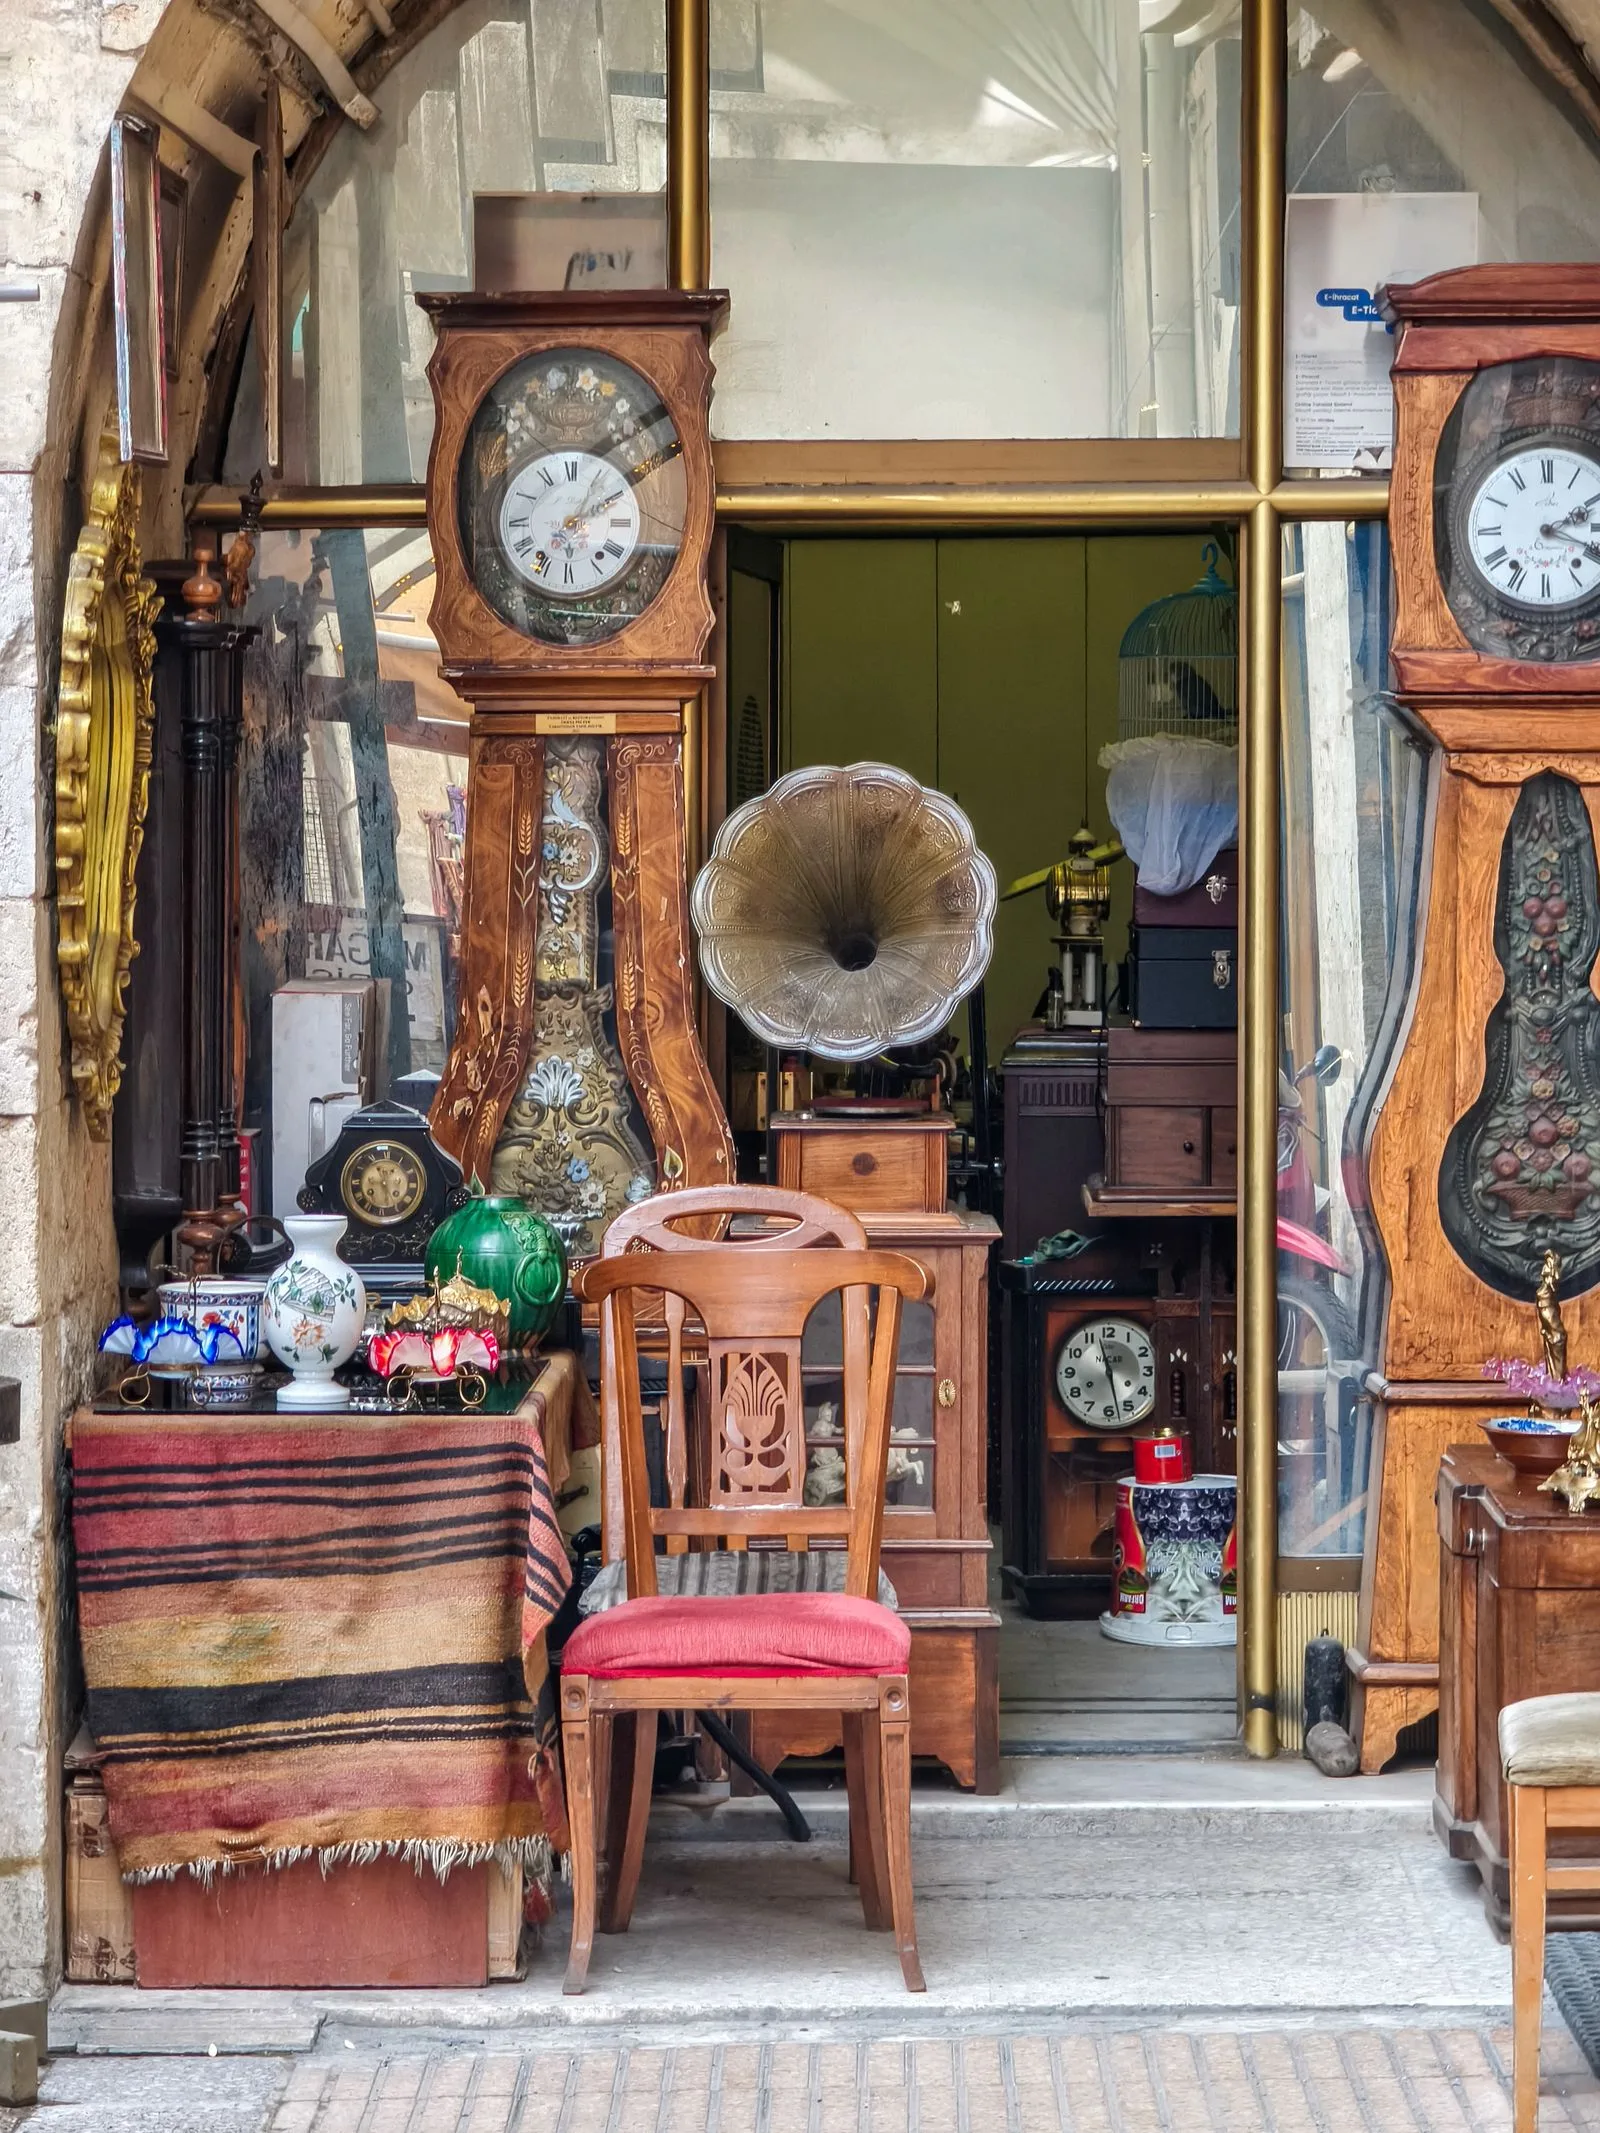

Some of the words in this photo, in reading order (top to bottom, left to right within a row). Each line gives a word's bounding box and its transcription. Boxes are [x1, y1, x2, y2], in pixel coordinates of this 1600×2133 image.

[564, 461, 577, 482] XII
[1541, 459, 1554, 484] XII
[1568, 467, 1582, 490] I
[343, 1033, 352, 1043] Go
[344, 1044, 353, 1072] Further
[1084, 1332, 1095, 1344] 11
[1102, 1327, 1116, 1339] 12
[1126, 1331, 1131, 1343] 1
[1069, 1348, 1083, 1359] 10
[1138, 1346, 1149, 1358] 2
[1095, 1355, 1123, 1364] NCAR
[1064, 1366, 1076, 1379] 9
[1142, 1365, 1154, 1377] 3
[1069, 1386, 1081, 1398] 8
[1137, 1385, 1148, 1397] 4
[1084, 1400, 1096, 1413] 7
[1103, 1405, 1115, 1417] 6
[1123, 1400, 1135, 1412] 5
